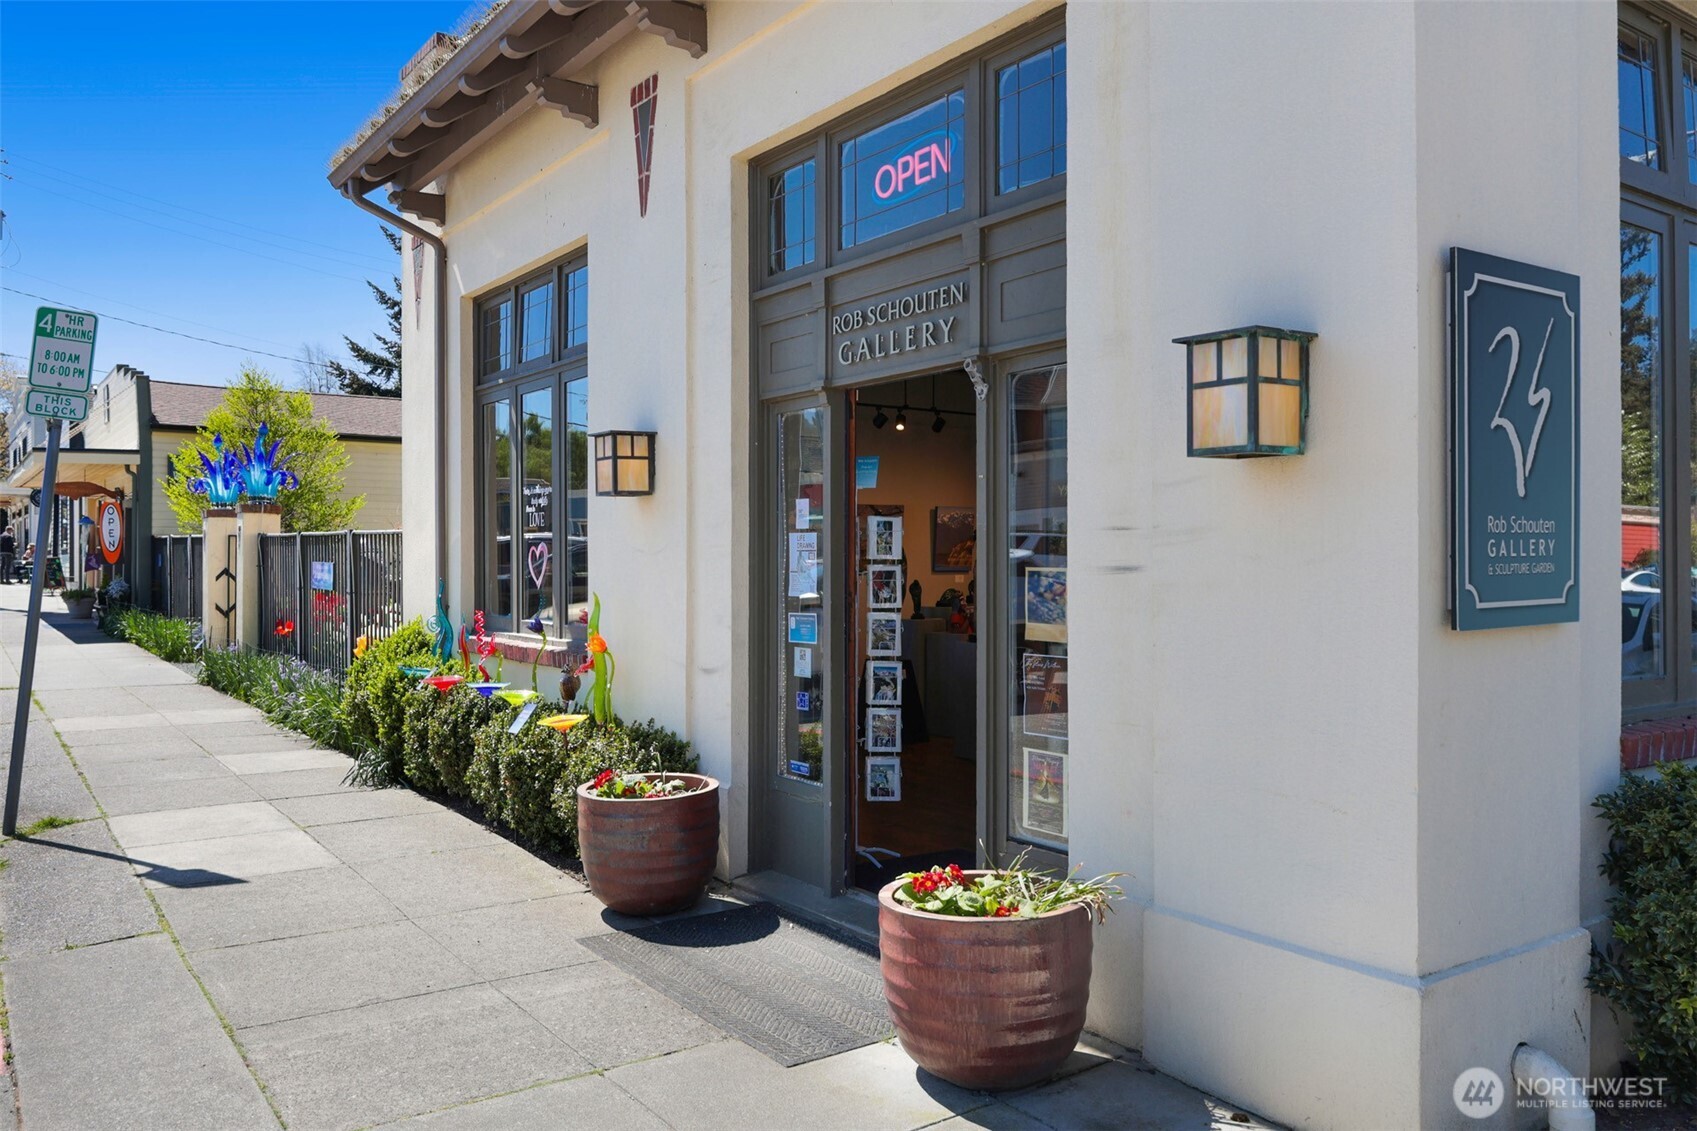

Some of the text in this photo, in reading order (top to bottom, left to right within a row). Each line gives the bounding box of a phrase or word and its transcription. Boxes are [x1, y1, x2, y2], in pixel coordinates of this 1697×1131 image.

[874, 137, 951, 199] OPEN
[833, 282, 965, 335] ROB SCHOUTEN
[38, 313, 84, 333] 4 HR
[55, 325, 93, 341] PARKING
[838, 316, 956, 365] GALLERY
[44, 349, 81, 364] 8:00 AM
[37, 363, 85, 378] TO 6:00 PM
[44, 395, 72, 406] THIS
[35, 404, 77, 416] BLOCK
[107, 506, 115, 549] OPEN
[529, 512, 545, 527] LOVE
[1487, 515, 1556, 534] Rob Schouten
[1487, 539, 1556, 558] GALLERY
[1495, 563, 1530, 575] SCULPTURE
[1531, 563, 1556, 574] GARDEN
